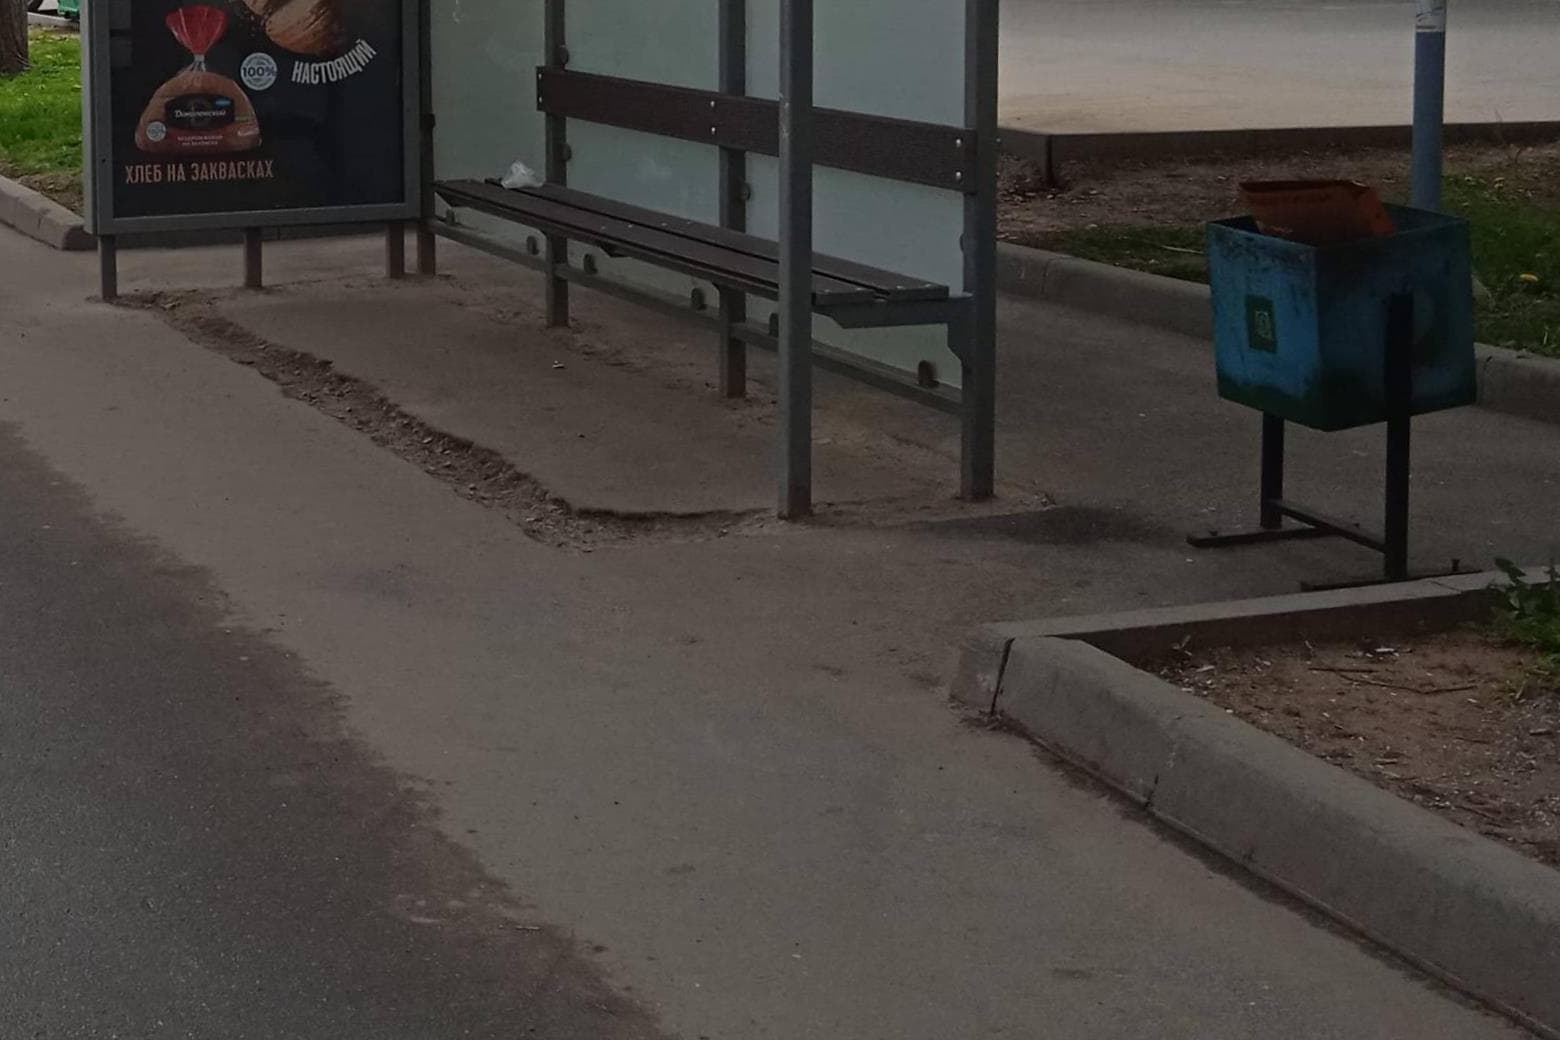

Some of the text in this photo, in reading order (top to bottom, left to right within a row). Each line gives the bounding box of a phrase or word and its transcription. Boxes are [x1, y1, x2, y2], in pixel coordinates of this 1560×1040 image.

[243, 66, 278, 78] 100%
[291, 38, 377, 85] НАСТОЯЩИЙ
[125, 159, 274, 185] ХЛЕБ НА ЗАКВАСКАХ
